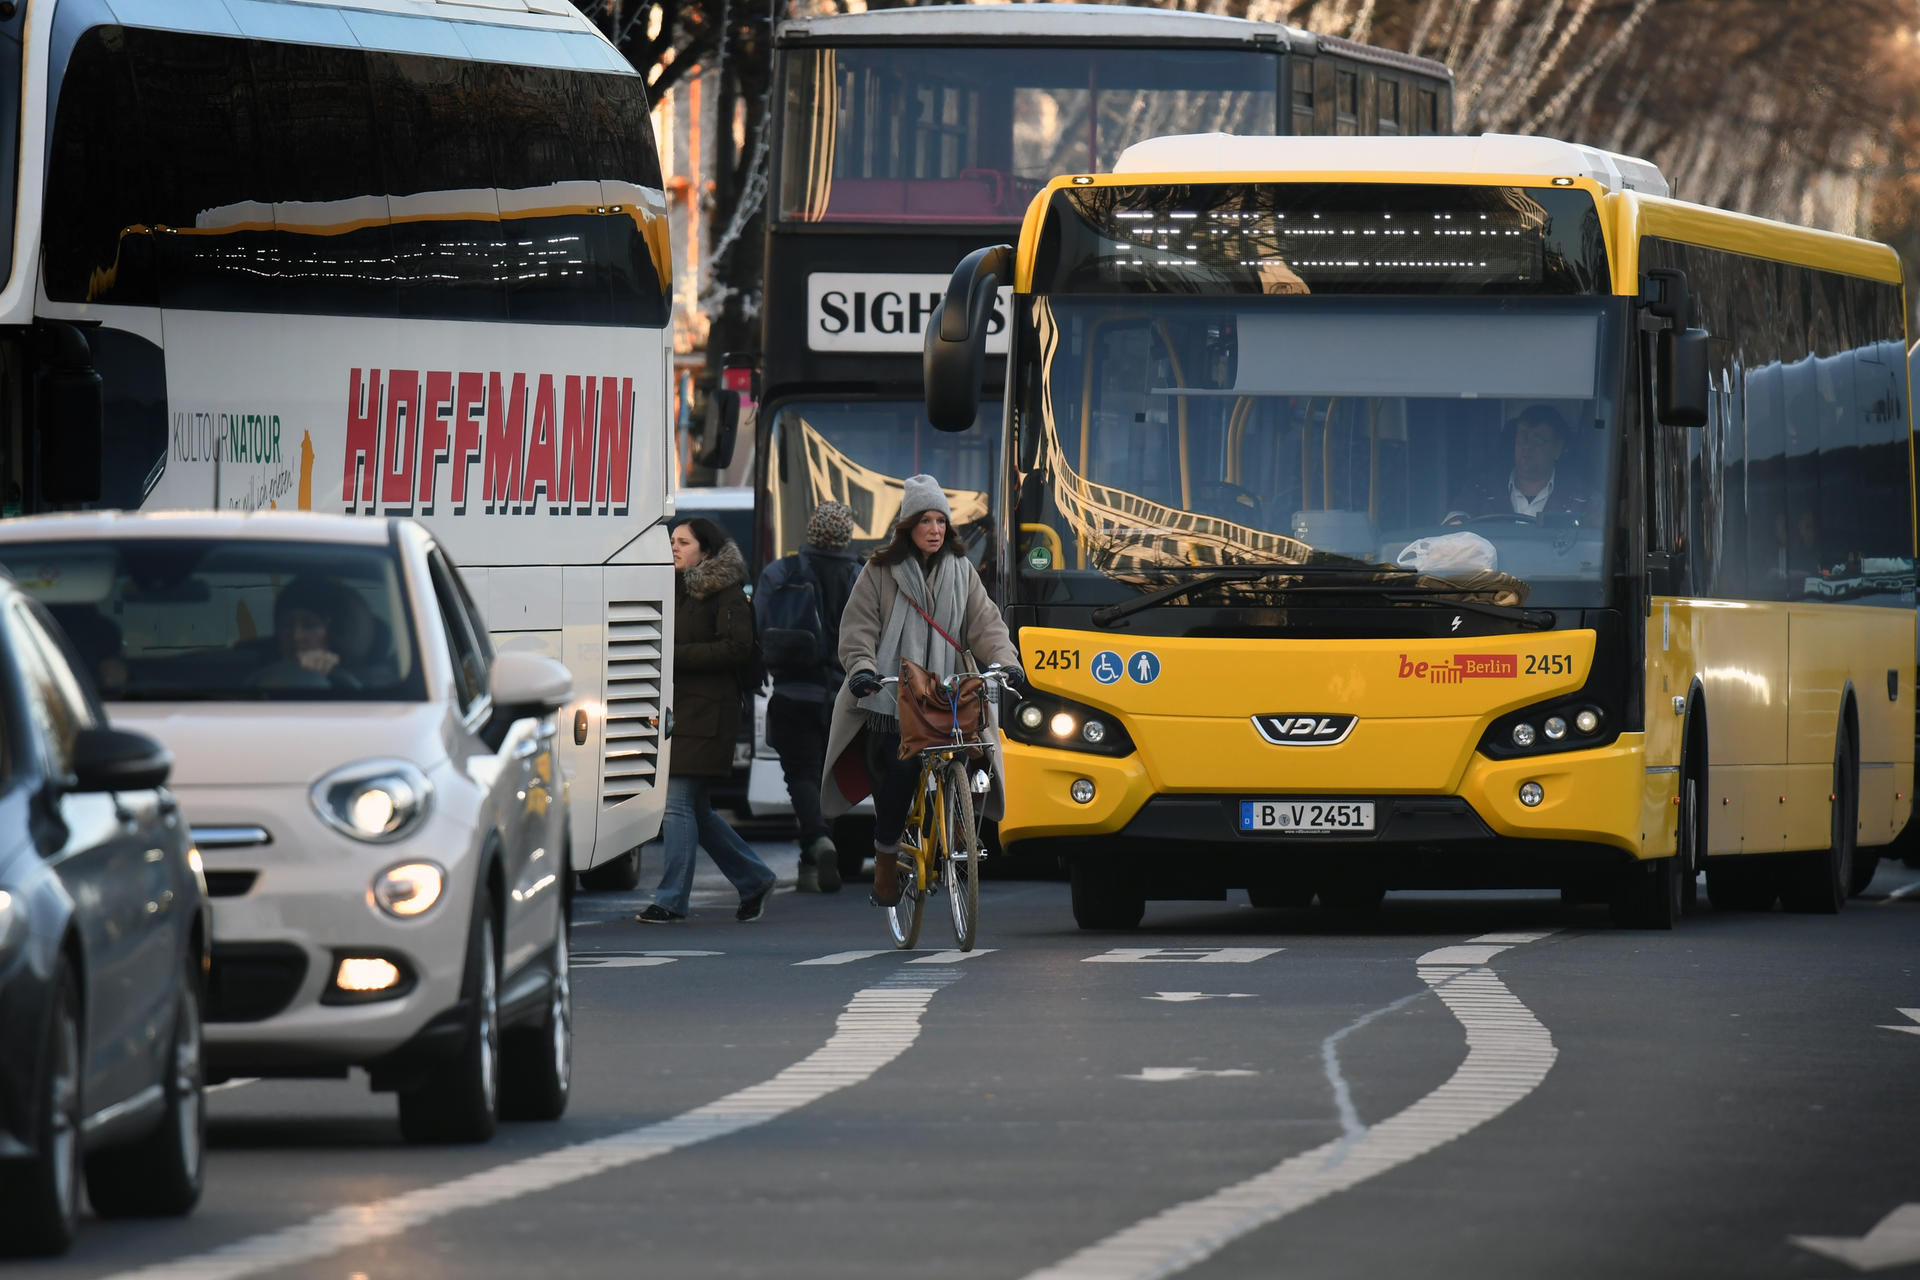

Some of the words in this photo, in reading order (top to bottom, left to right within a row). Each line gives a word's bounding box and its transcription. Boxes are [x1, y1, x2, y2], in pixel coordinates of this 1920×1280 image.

[173, 412, 281, 464] KULTOURNATOUR
[342, 367, 636, 517] HOFFMANN
[1034, 650, 1080, 670] 2451
[1398, 654, 1429, 678] be
[1466, 660, 1511, 674] Berlin
[1525, 654, 1572, 674] 2451
[1269, 718, 1337, 736] VDL
[1262, 805, 1276, 826] B
[1291, 806, 1304, 826] V
[1310, 806, 1364, 826] 2451
